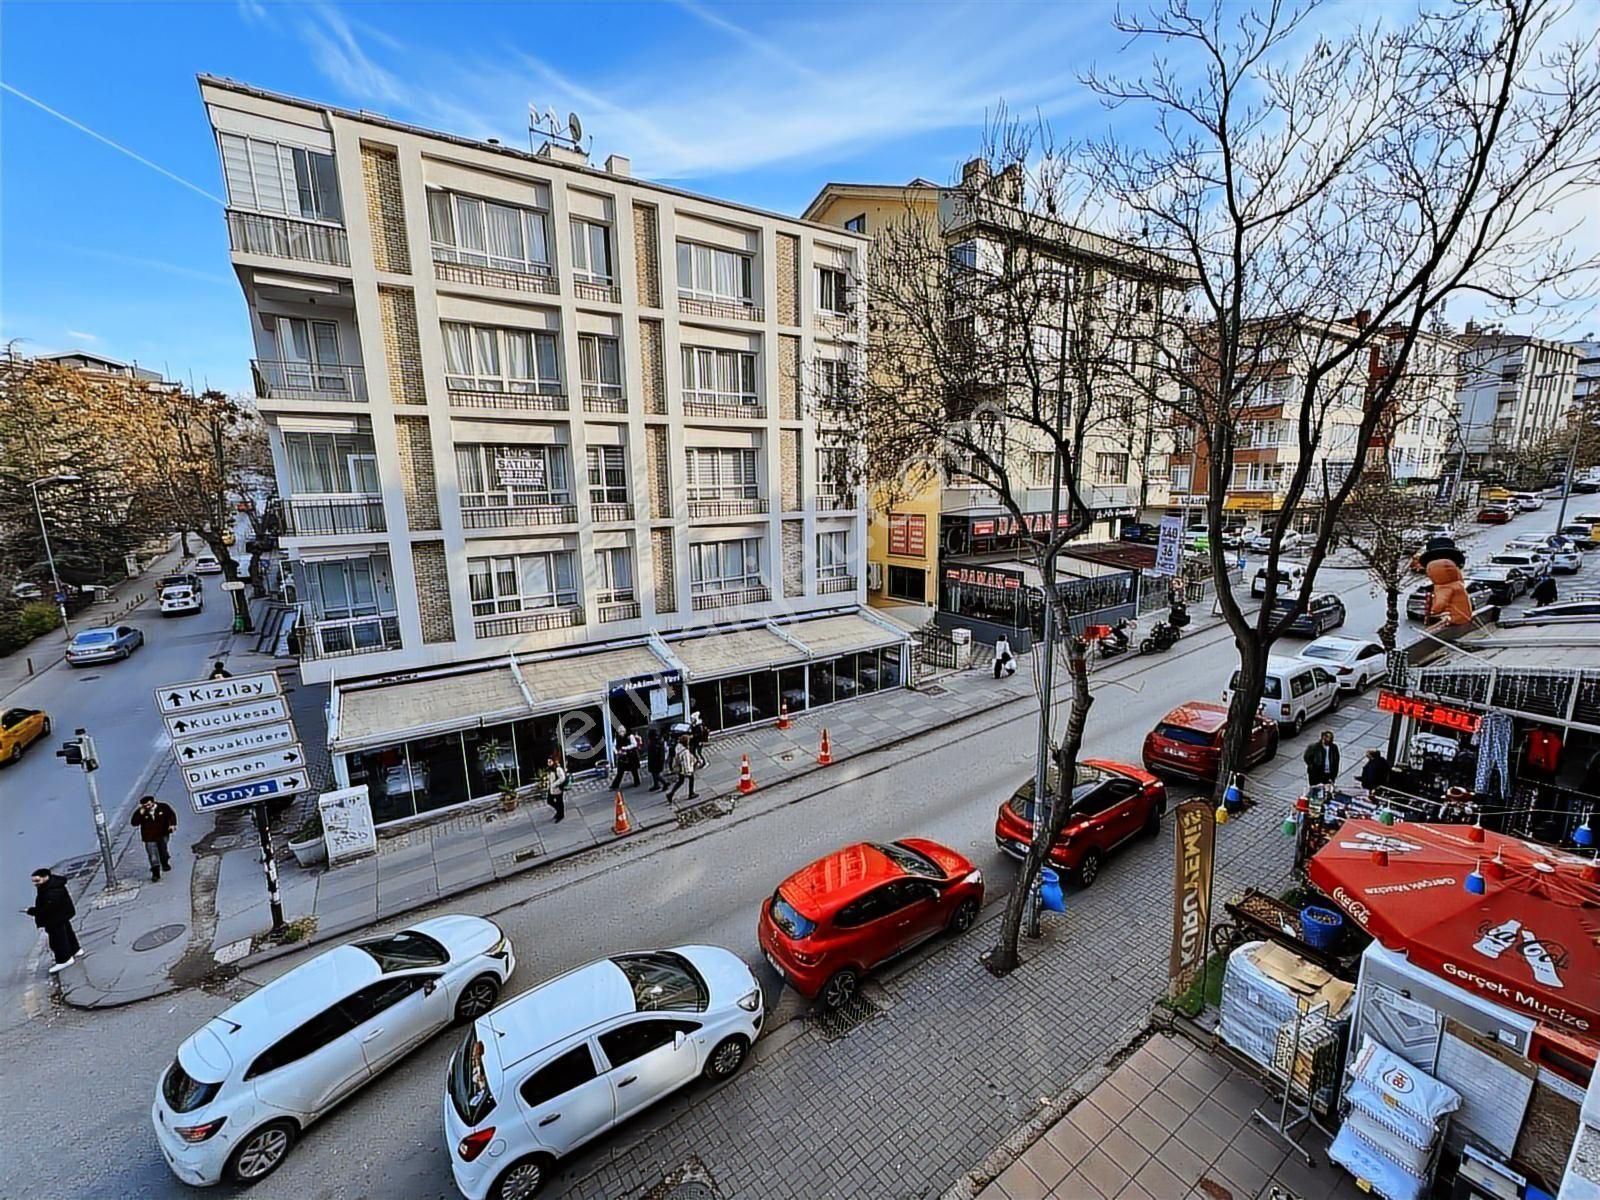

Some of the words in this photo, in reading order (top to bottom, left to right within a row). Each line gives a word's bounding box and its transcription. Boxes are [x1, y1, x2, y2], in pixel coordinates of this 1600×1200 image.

[498, 460, 541, 469] SATILIK
[189, 680, 264, 702] Kızılay
[198, 730, 289, 755] Kavaklıdere
[189, 761, 266, 784] Dikmen
[202, 784, 270, 805] Konya
[1443, 962, 1510, 998] Gerçek
[1515, 991, 1590, 1031] Mucize
